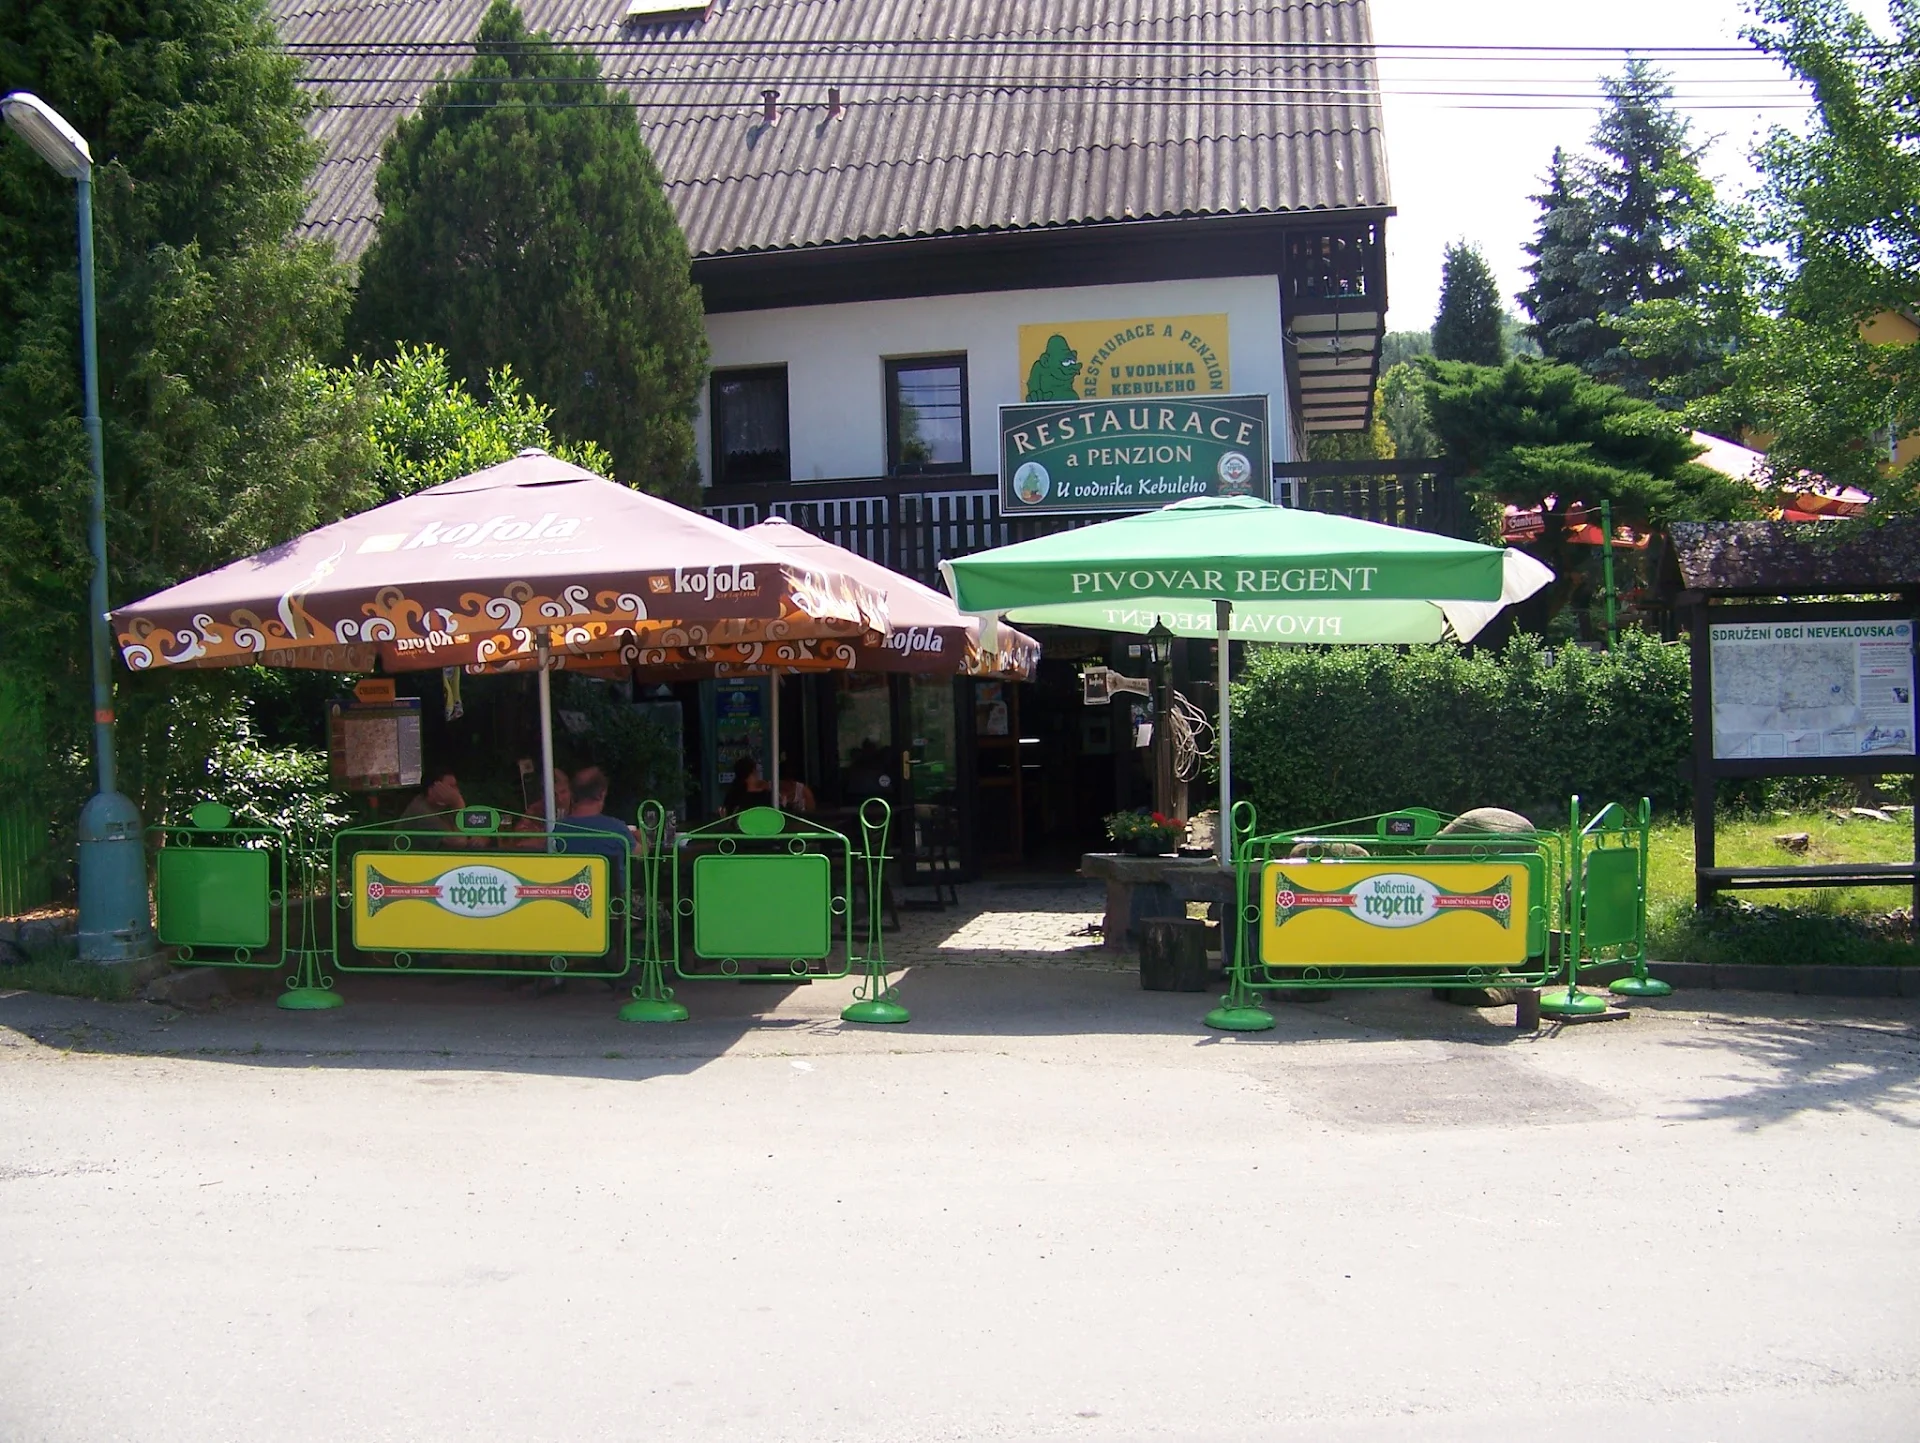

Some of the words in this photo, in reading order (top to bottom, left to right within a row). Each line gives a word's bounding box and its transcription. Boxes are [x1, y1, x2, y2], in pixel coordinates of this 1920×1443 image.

[1084, 324, 1155, 397] RESTAURACE
[1163, 325, 1172, 337] A
[1180, 329, 1223, 390] PENZION
[1111, 366, 1120, 378] U
[1126, 362, 1196, 377] VODNÍKA
[1111, 379, 1196, 396] KEBULEHO
[1013, 408, 1253, 455] RESTAURACE
[1067, 452, 1078, 467] a
[1088, 446, 1192, 466] PENZION
[1056, 481, 1070, 497] U
[1074, 475, 1132, 497] vodníka
[1138, 475, 1207, 495] Kebuleho
[402, 512, 581, 551] kofola
[674, 564, 756, 601] kofola
[1071, 569, 1226, 595] PIVOVAR
[1234, 567, 1378, 593] REGENT
[1712, 626, 1771, 641] SDRUŽENÍ
[1775, 626, 1803, 639] OBCÍ
[1808, 626, 1895, 639] NEVEKLOVSKA
[457, 872, 498, 885] Bohemia
[1373, 880, 1415, 894] Bohemia
[449, 883, 507, 910] regent
[1364, 893, 1425, 920] regent
